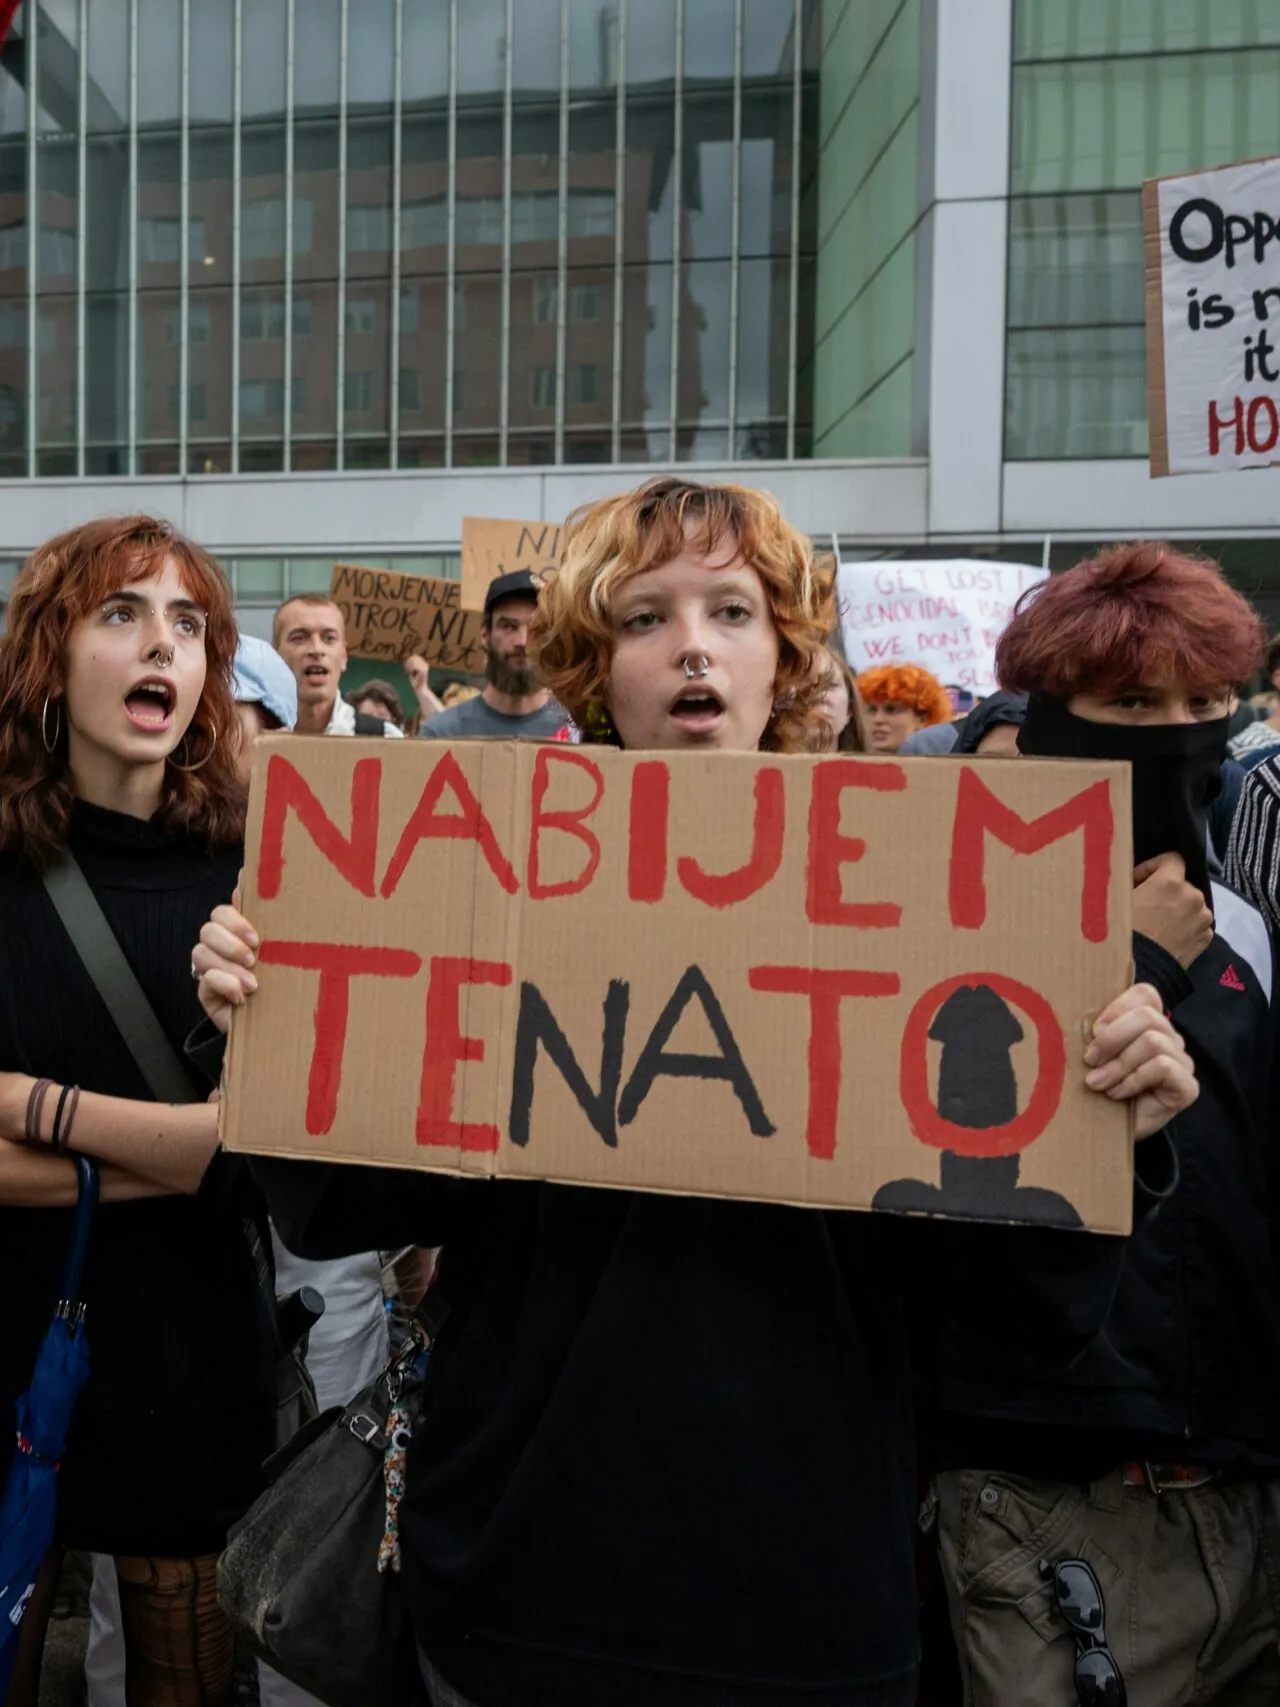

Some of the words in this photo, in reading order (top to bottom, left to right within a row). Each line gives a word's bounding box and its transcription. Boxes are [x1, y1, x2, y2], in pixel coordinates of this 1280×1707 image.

[1169, 198, 1280, 269] Opp
[1186, 287, 1234, 331] is
[1243, 328, 1279, 382] it
[333, 567, 461, 608] MORJENJE
[945, 567, 1004, 593] LOST
[427, 608, 468, 645] NI
[862, 634, 905, 660] WE
[257, 748, 1115, 943] NABIJEM
